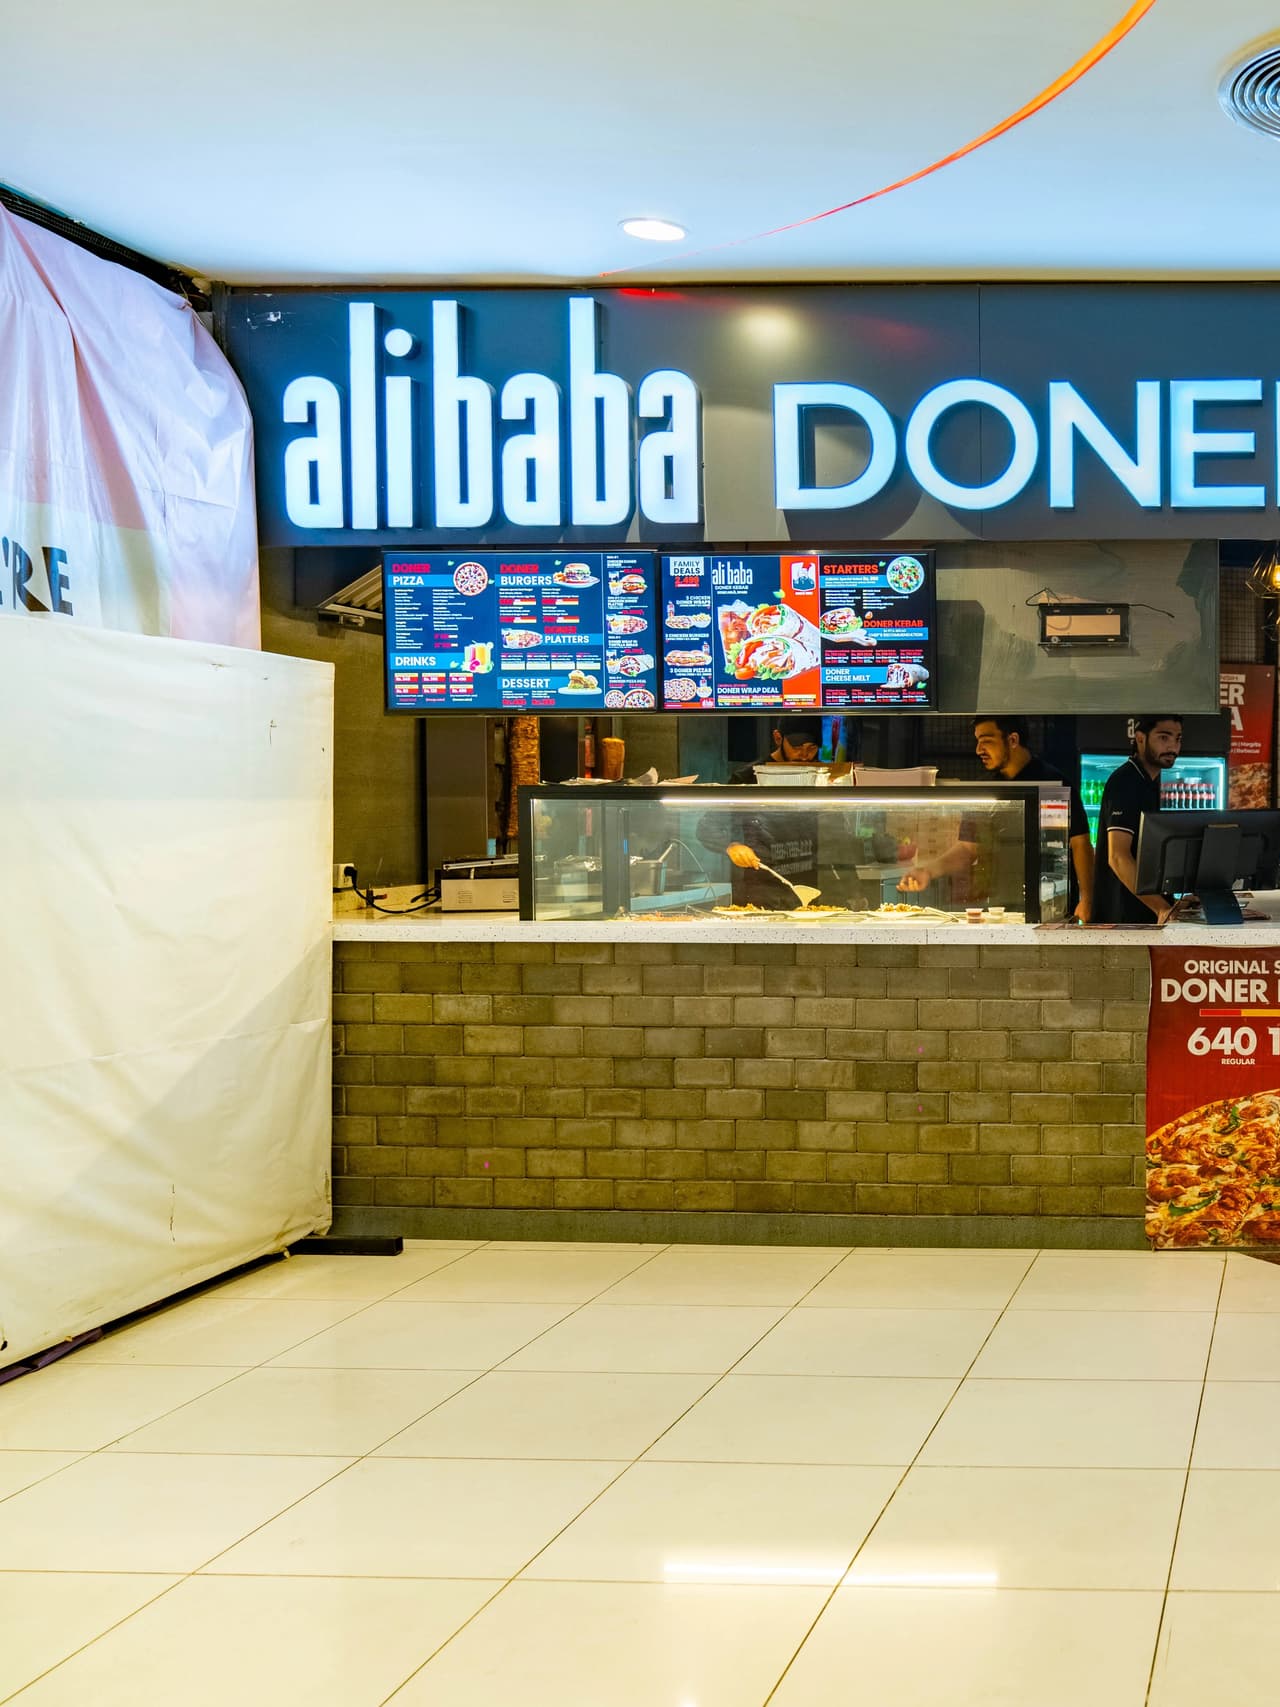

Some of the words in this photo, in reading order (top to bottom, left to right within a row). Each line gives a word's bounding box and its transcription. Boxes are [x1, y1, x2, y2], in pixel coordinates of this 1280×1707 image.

[823, 564, 879, 574] STARTERS
[392, 575, 424, 586] PIZZA
[500, 575, 552, 586] BURGERS
[544, 635, 590, 643] PLATTERS
[395, 656, 436, 666] DRINKS
[502, 678, 550, 688] DESSERT
[1184, 959, 1270, 975] ORIGINAL
[1160, 979, 1269, 1003] DONER
[1187, 1027, 1257, 1056] 640
